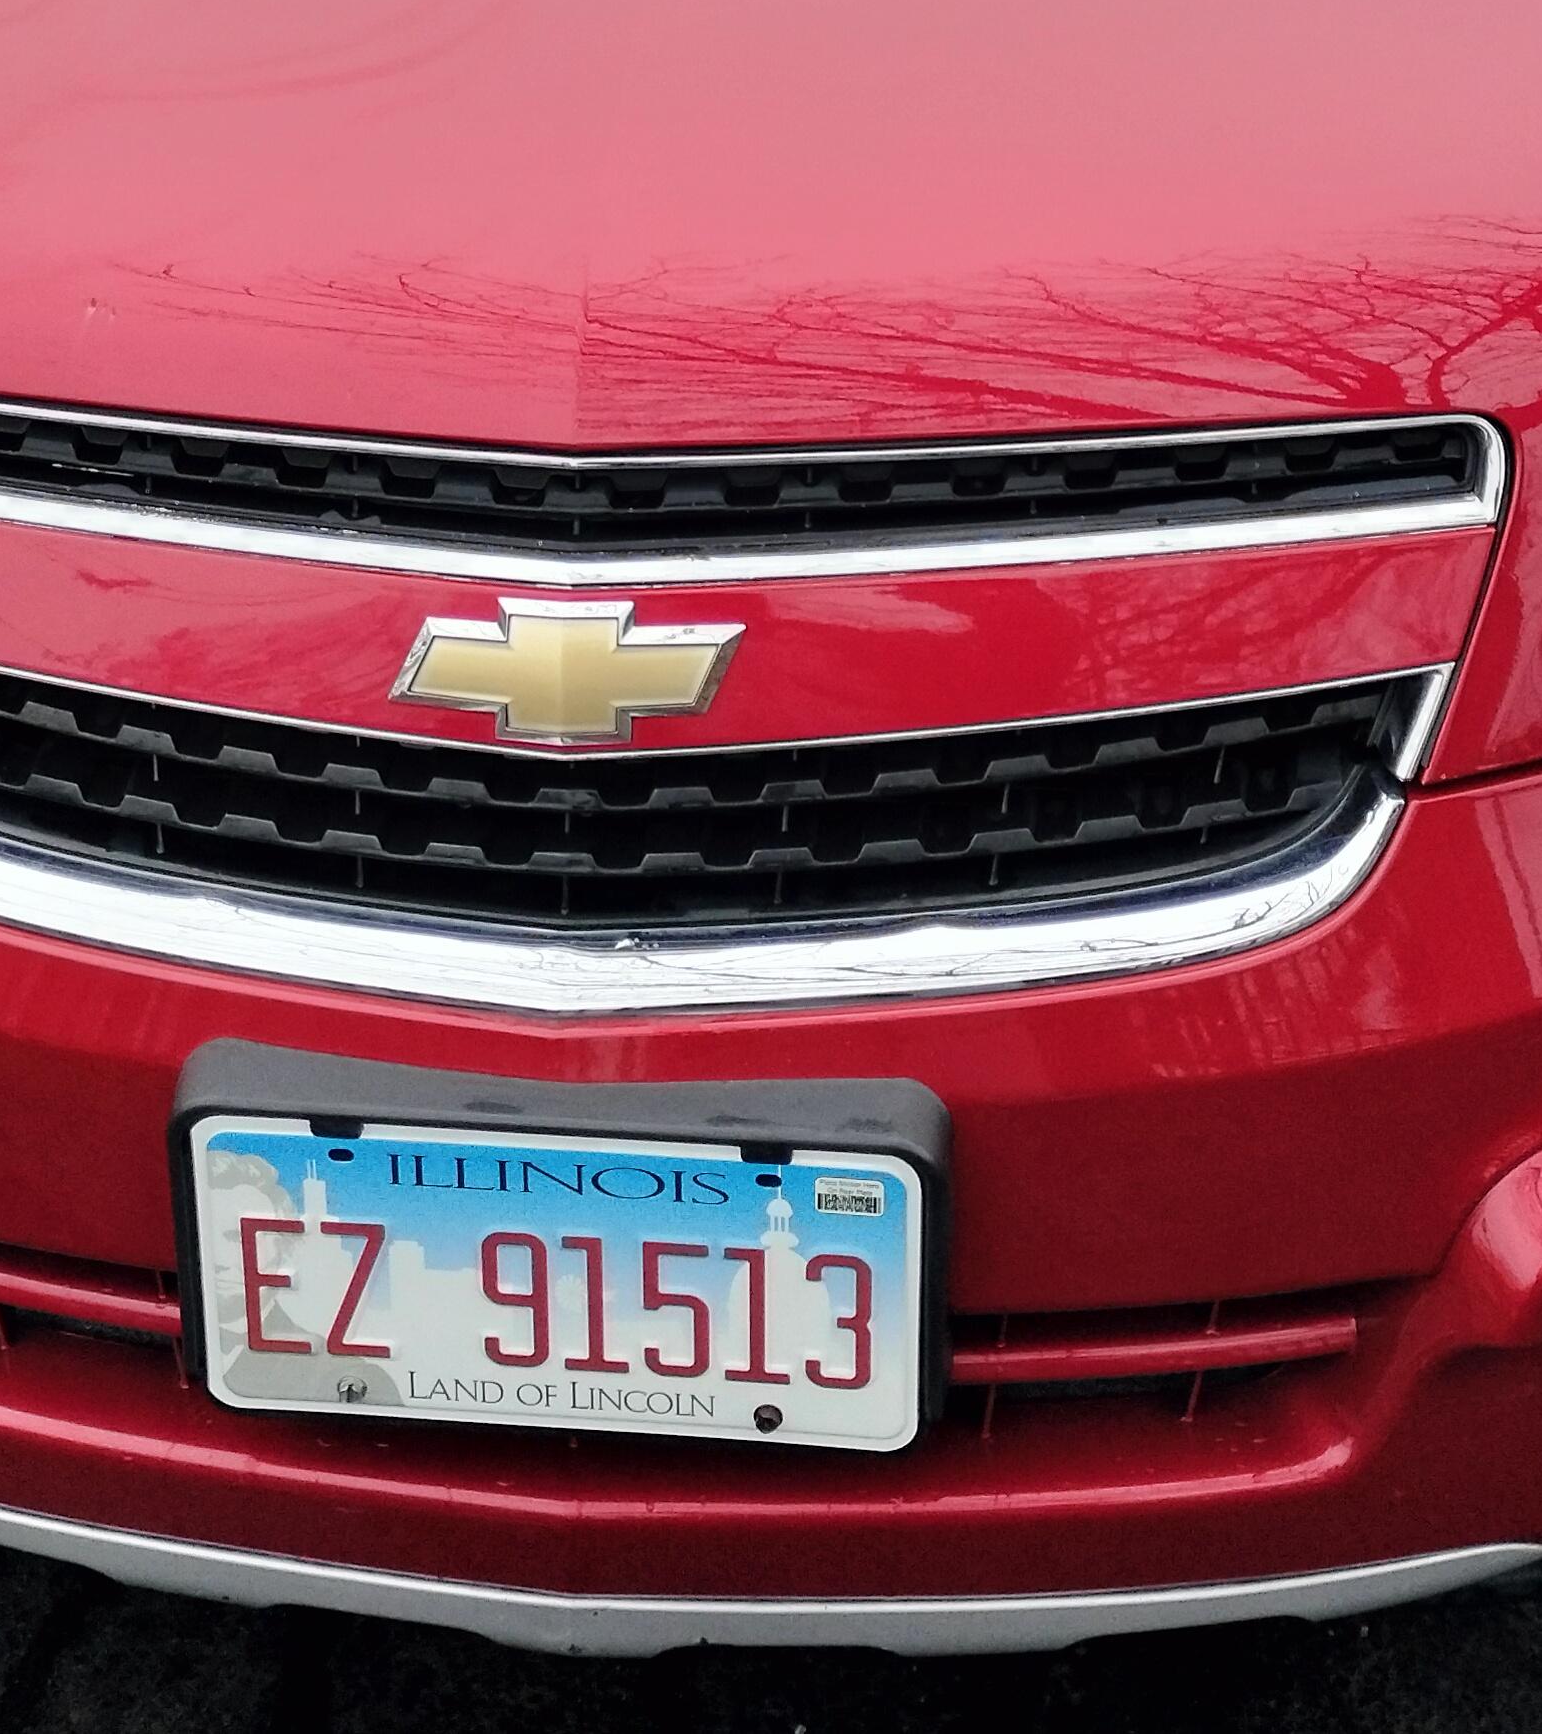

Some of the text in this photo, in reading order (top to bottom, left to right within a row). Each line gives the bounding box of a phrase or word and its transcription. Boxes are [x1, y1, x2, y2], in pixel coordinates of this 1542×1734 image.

[388, 1153, 731, 1207] ILLINOIS
[239, 1217, 872, 1390] EZ 91513
